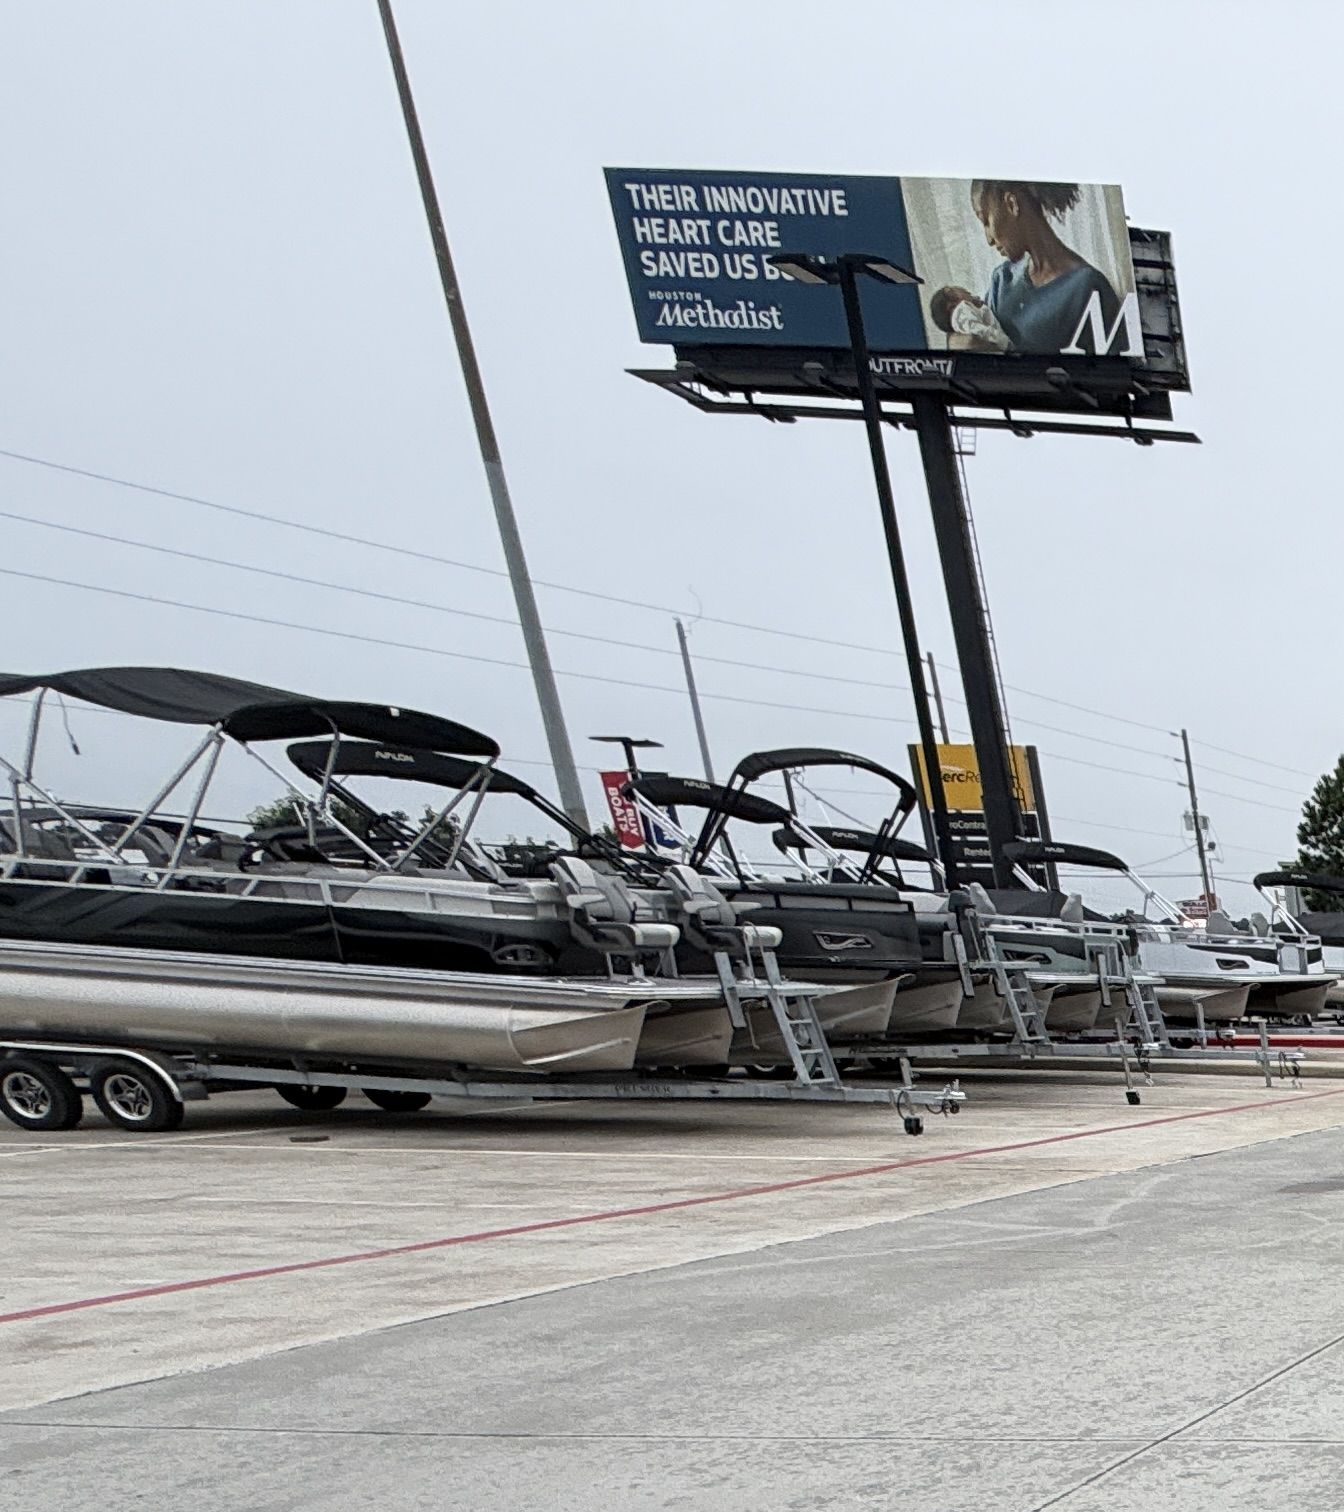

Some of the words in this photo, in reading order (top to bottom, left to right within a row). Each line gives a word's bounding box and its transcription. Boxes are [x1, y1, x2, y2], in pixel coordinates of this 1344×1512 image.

[624, 183, 699, 212] THEIR
[703, 184, 849, 216] INNOVATIVE
[632, 216, 712, 246] HEART
[717, 219, 782, 248] CARE
[640, 250, 720, 279] SAVED
[723, 252, 759, 280] US
[648, 290, 703, 301] HOUSTON
[655, 300, 785, 330] Methodist
[608, 786, 629, 832] BOATS
